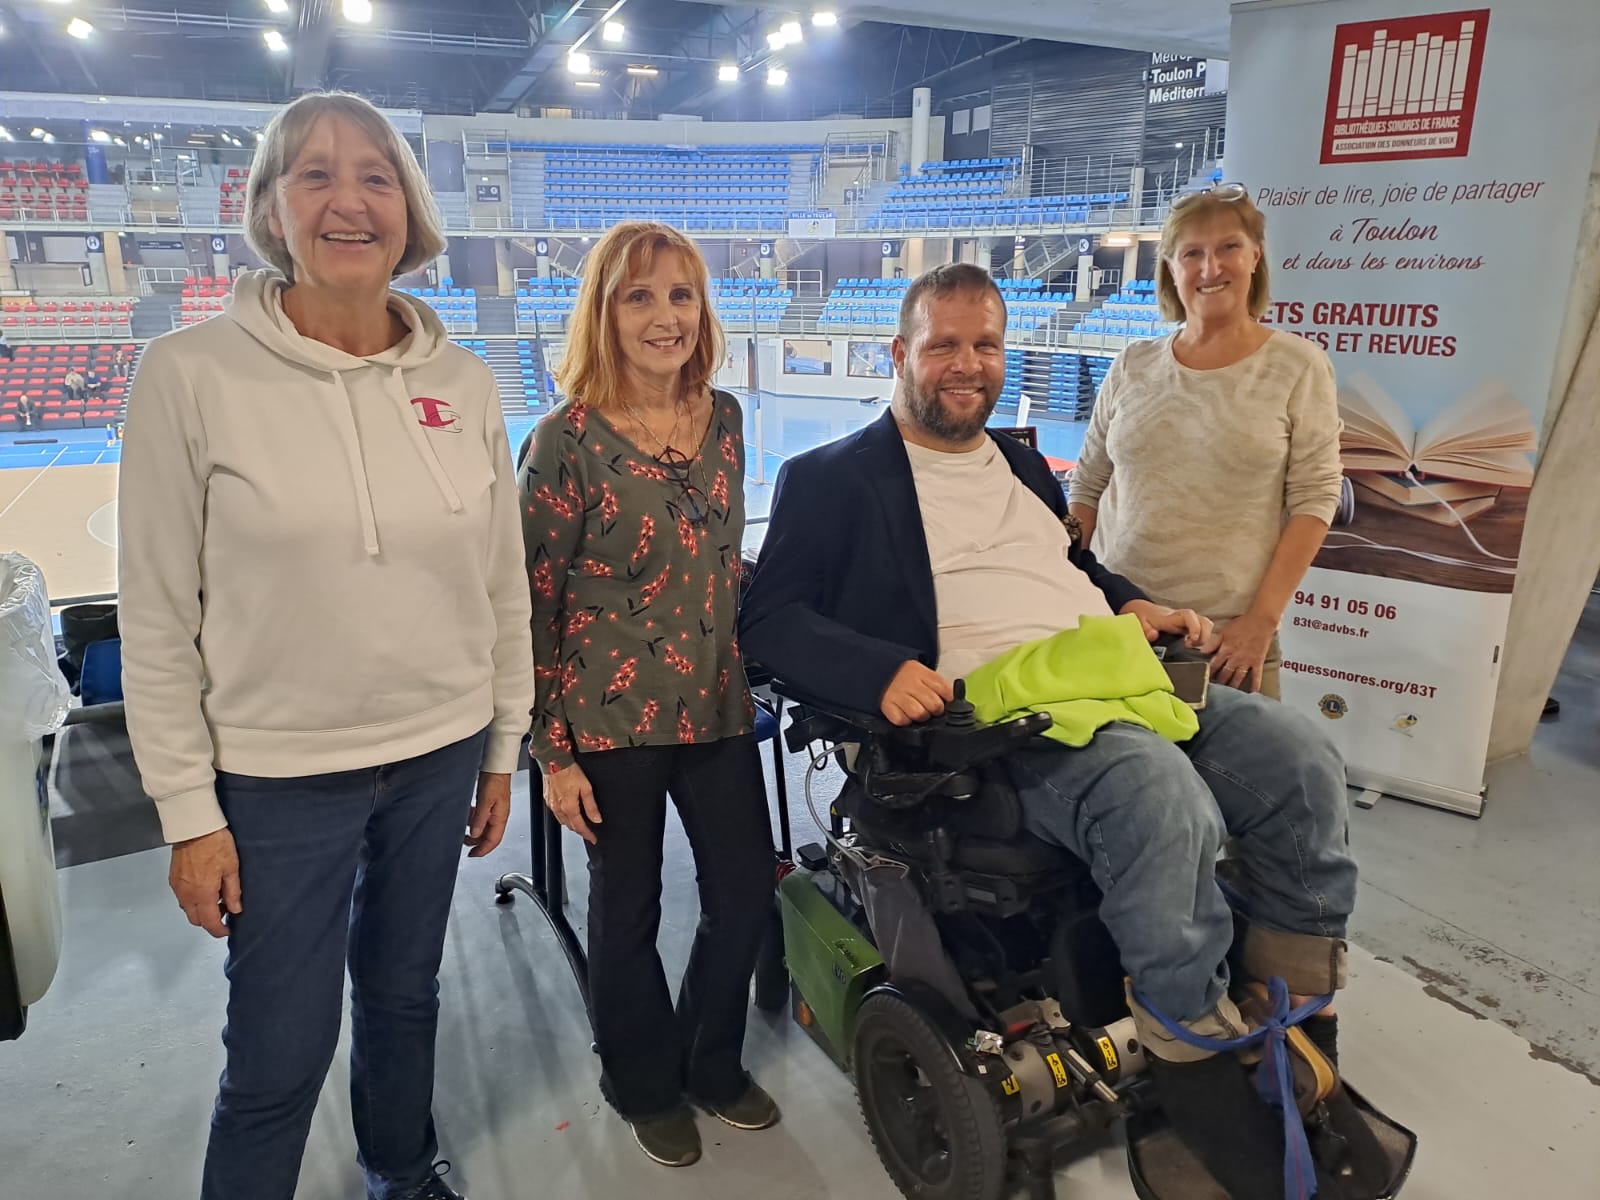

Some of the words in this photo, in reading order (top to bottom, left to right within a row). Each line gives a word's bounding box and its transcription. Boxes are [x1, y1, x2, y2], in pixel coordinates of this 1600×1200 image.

[1151, 67, 1193, 84] Toulon
[1196, 61, 1207, 78] P
[1149, 85, 1226, 104] Méditerr
[1387, 118, 1420, 133] SONORES
[1421, 118, 1431, 131] DE
[1431, 115, 1461, 129] FRANCE
[1335, 141, 1376, 151] ASSOCIATION
[1377, 140, 1390, 149] DES
[1391, 137, 1427, 148] DONNEURS
[1428, 137, 1437, 146] DE
[1256, 187, 1311, 207] Plaisir
[1314, 186, 1338, 205] de
[1343, 184, 1375, 207] lire,
[1379, 183, 1418, 208] joie
[1423, 181, 1448, 202] de
[1450, 180, 1545, 205] partager
[1329, 224, 1344, 242] à
[1351, 217, 1439, 245] Toulon
[1282, 253, 1301, 270] et
[1305, 251, 1356, 270] dans
[1360, 251, 1390, 271] les
[1395, 253, 1486, 271] environs
[1312, 302, 1439, 328] GRATUITS
[1335, 332, 1363, 353] ET
[1368, 333, 1457, 357] REVUES
[1294, 590, 1315, 608] 94
[1320, 594, 1340, 611] 91
[1347, 598, 1369, 616] 05
[1374, 603, 1398, 620] 06
[1293, 615, 1370, 639] 83t@advbs.fr
[1280, 658, 1438, 699] equessonores.org/83T
